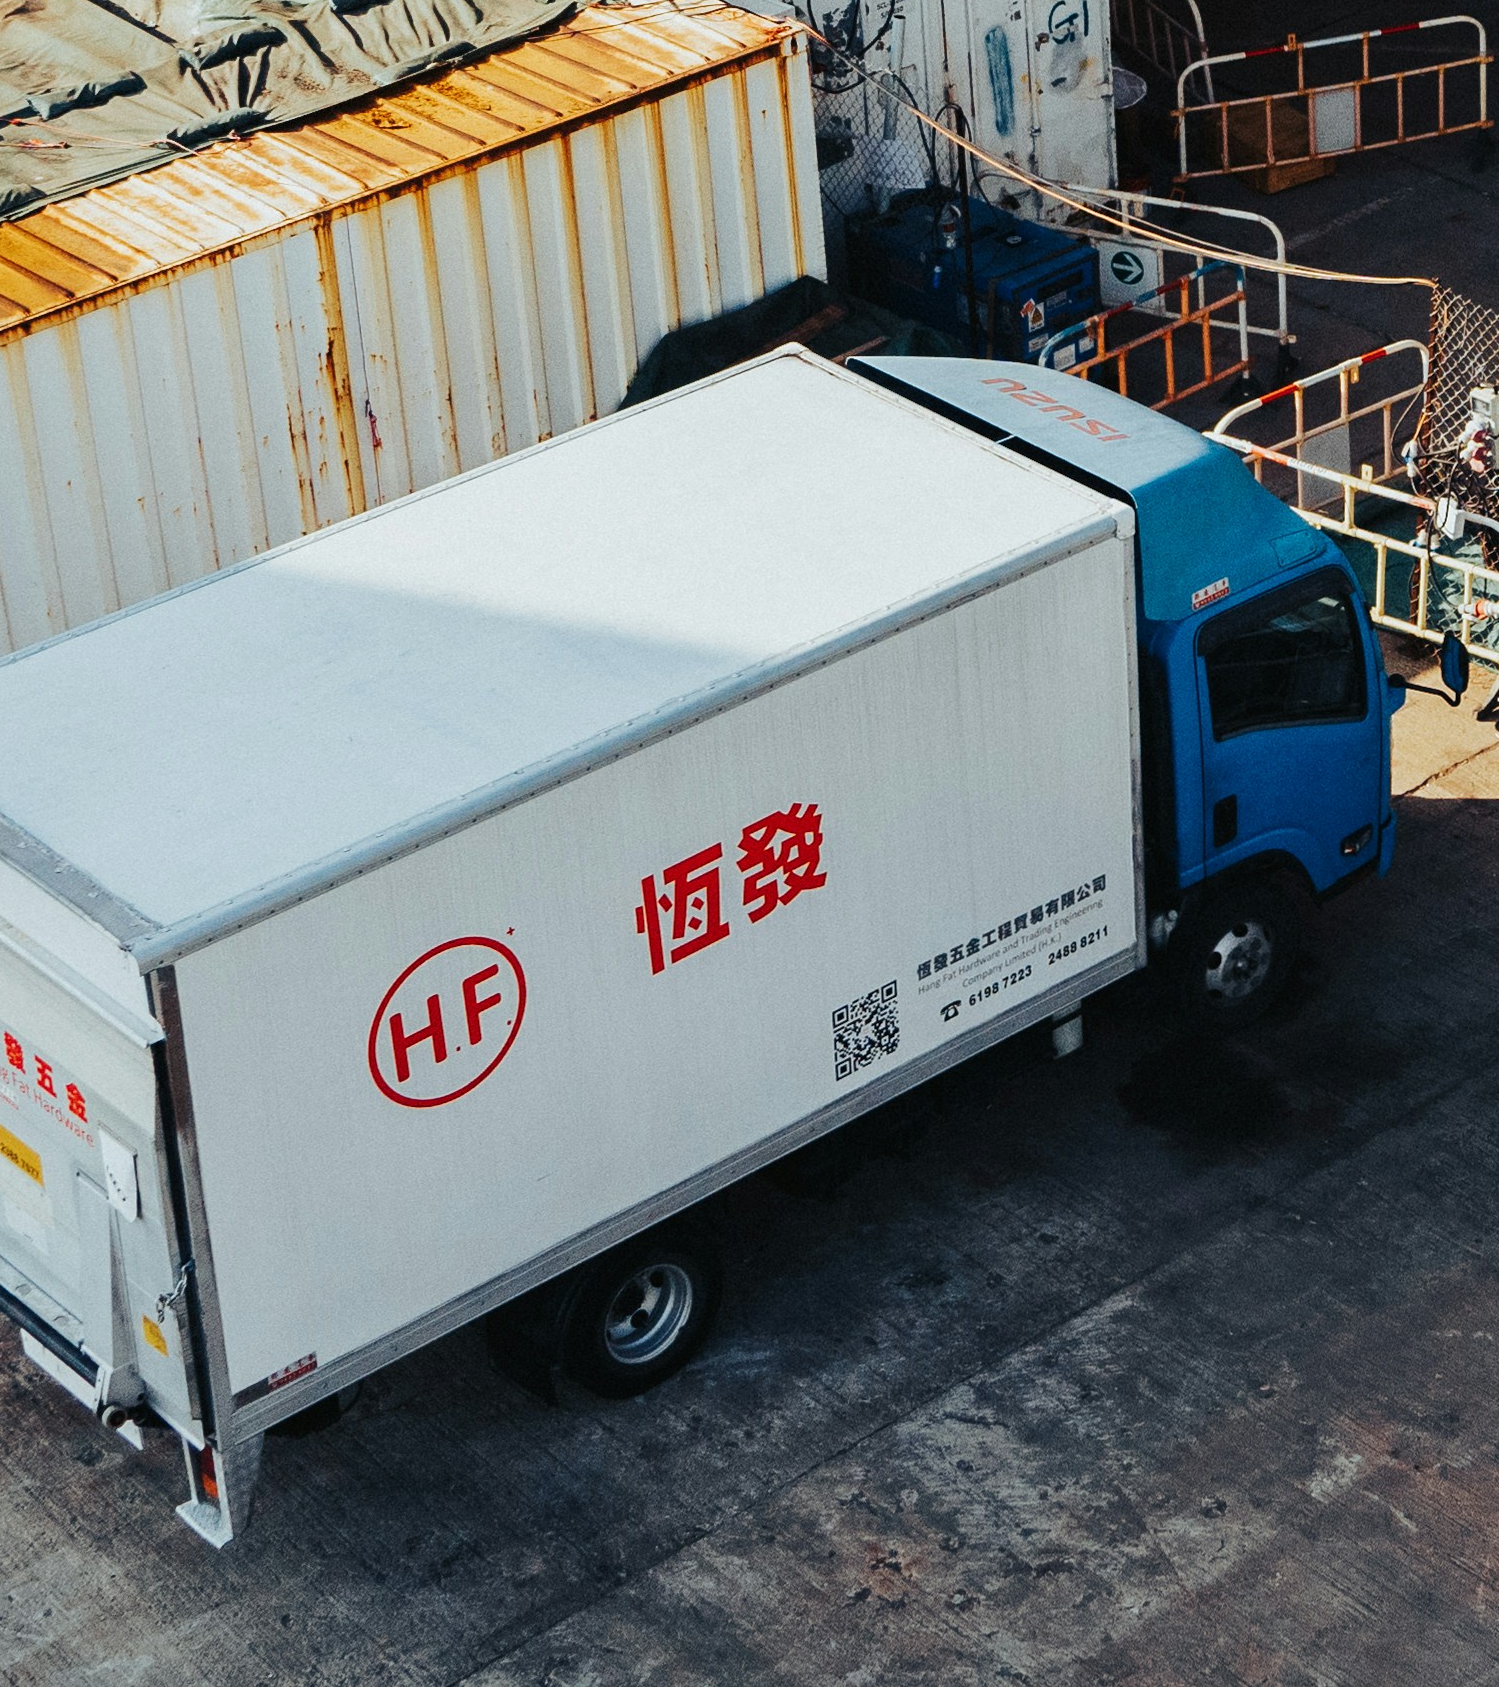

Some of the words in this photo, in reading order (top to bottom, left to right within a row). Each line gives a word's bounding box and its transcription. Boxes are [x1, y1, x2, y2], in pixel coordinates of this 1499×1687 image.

[981, 378, 1130, 441] ISUZU
[634, 802, 827, 975] 恆發
[918, 979, 941, 995] Hang
[943, 970, 957, 984] Fat
[958, 949, 1001, 976] Hardware
[1002, 940, 1020, 956] and
[1021, 922, 1053, 945] Trading
[1053, 898, 1104, 931] Engineering
[962, 964, 1003, 989] Company
[1004, 945, 1038, 969] Limited
[968, 982, 1000, 1007] 6198
[1002, 964, 1033, 989] 7223
[1048, 942, 1078, 965] 2488
[1079, 924, 1109, 949] 8211
[33, 1090, 95, 1148] Hardware
